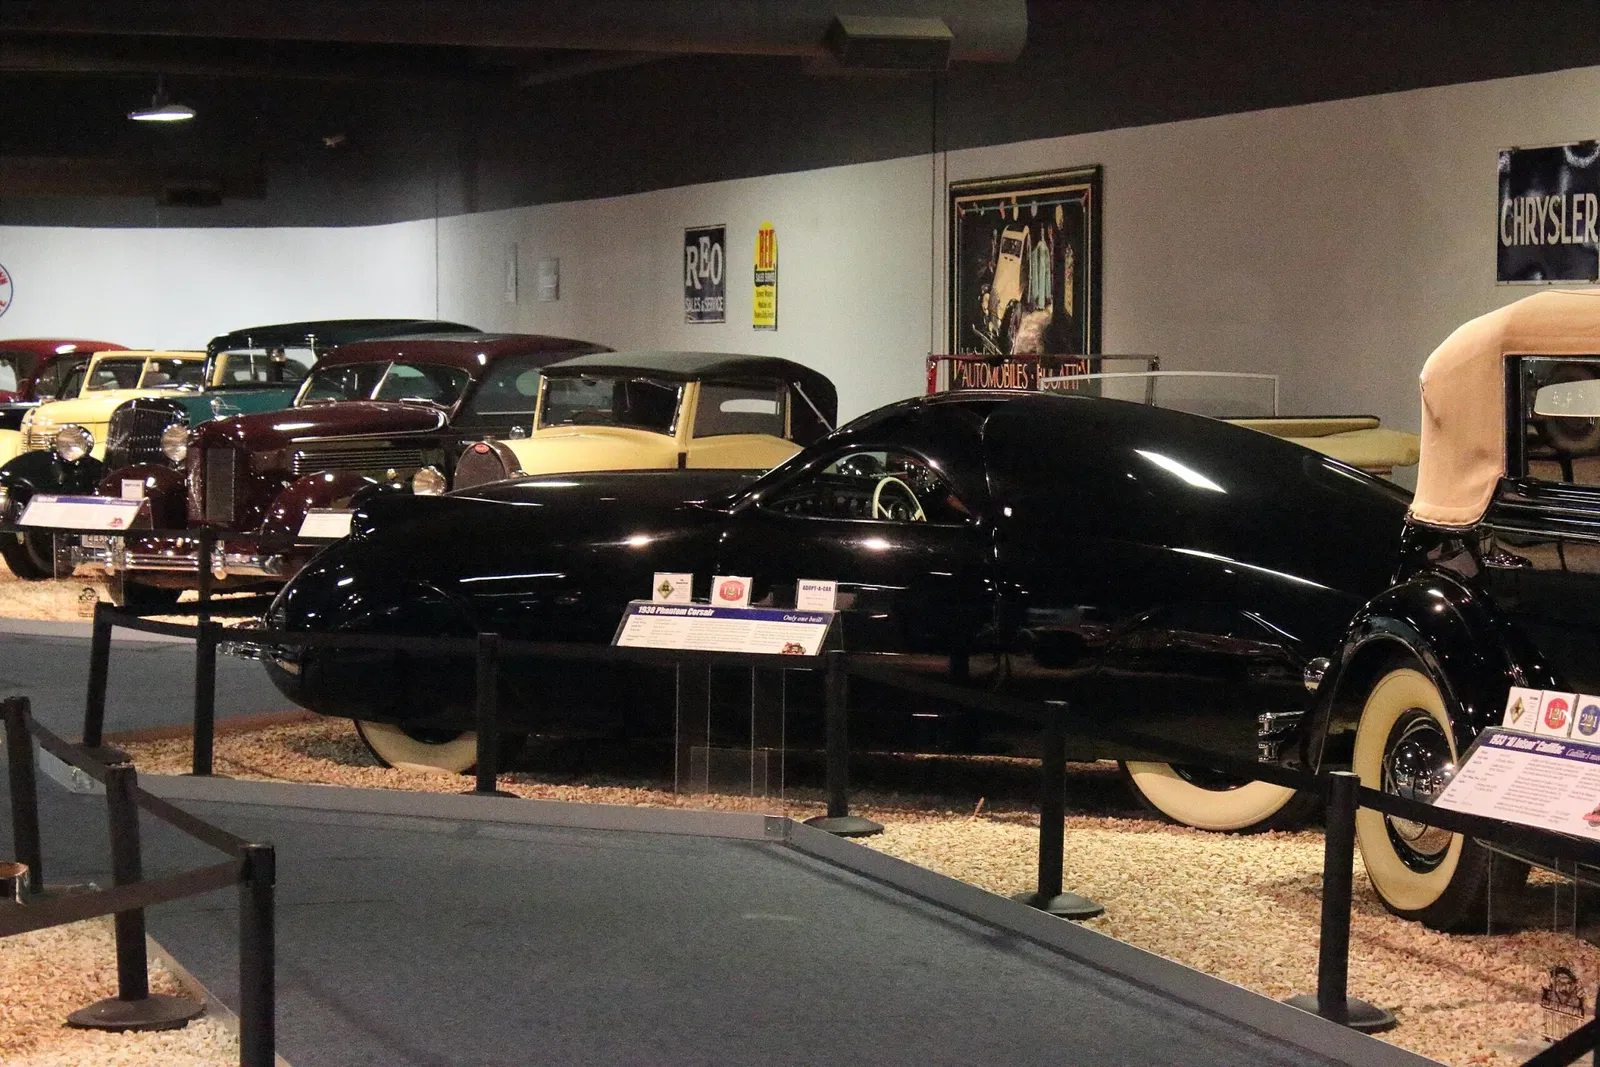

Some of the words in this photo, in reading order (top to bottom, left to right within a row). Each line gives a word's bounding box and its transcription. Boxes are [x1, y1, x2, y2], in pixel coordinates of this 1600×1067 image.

[1501, 192, 1599, 247] CHRYSLER
[685, 236, 723, 289] REO
[685, 297, 701, 312] SALES
[704, 296, 724, 312] SERVICE
[961, 362, 1029, 389] AUTOMOBILES
[656, 606, 687, 615] Phantom
[687, 608, 715, 616] Corsair
[783, 615, 797, 623] Only
[809, 615, 824, 623] built
[1579, 713, 1599, 728] 221
